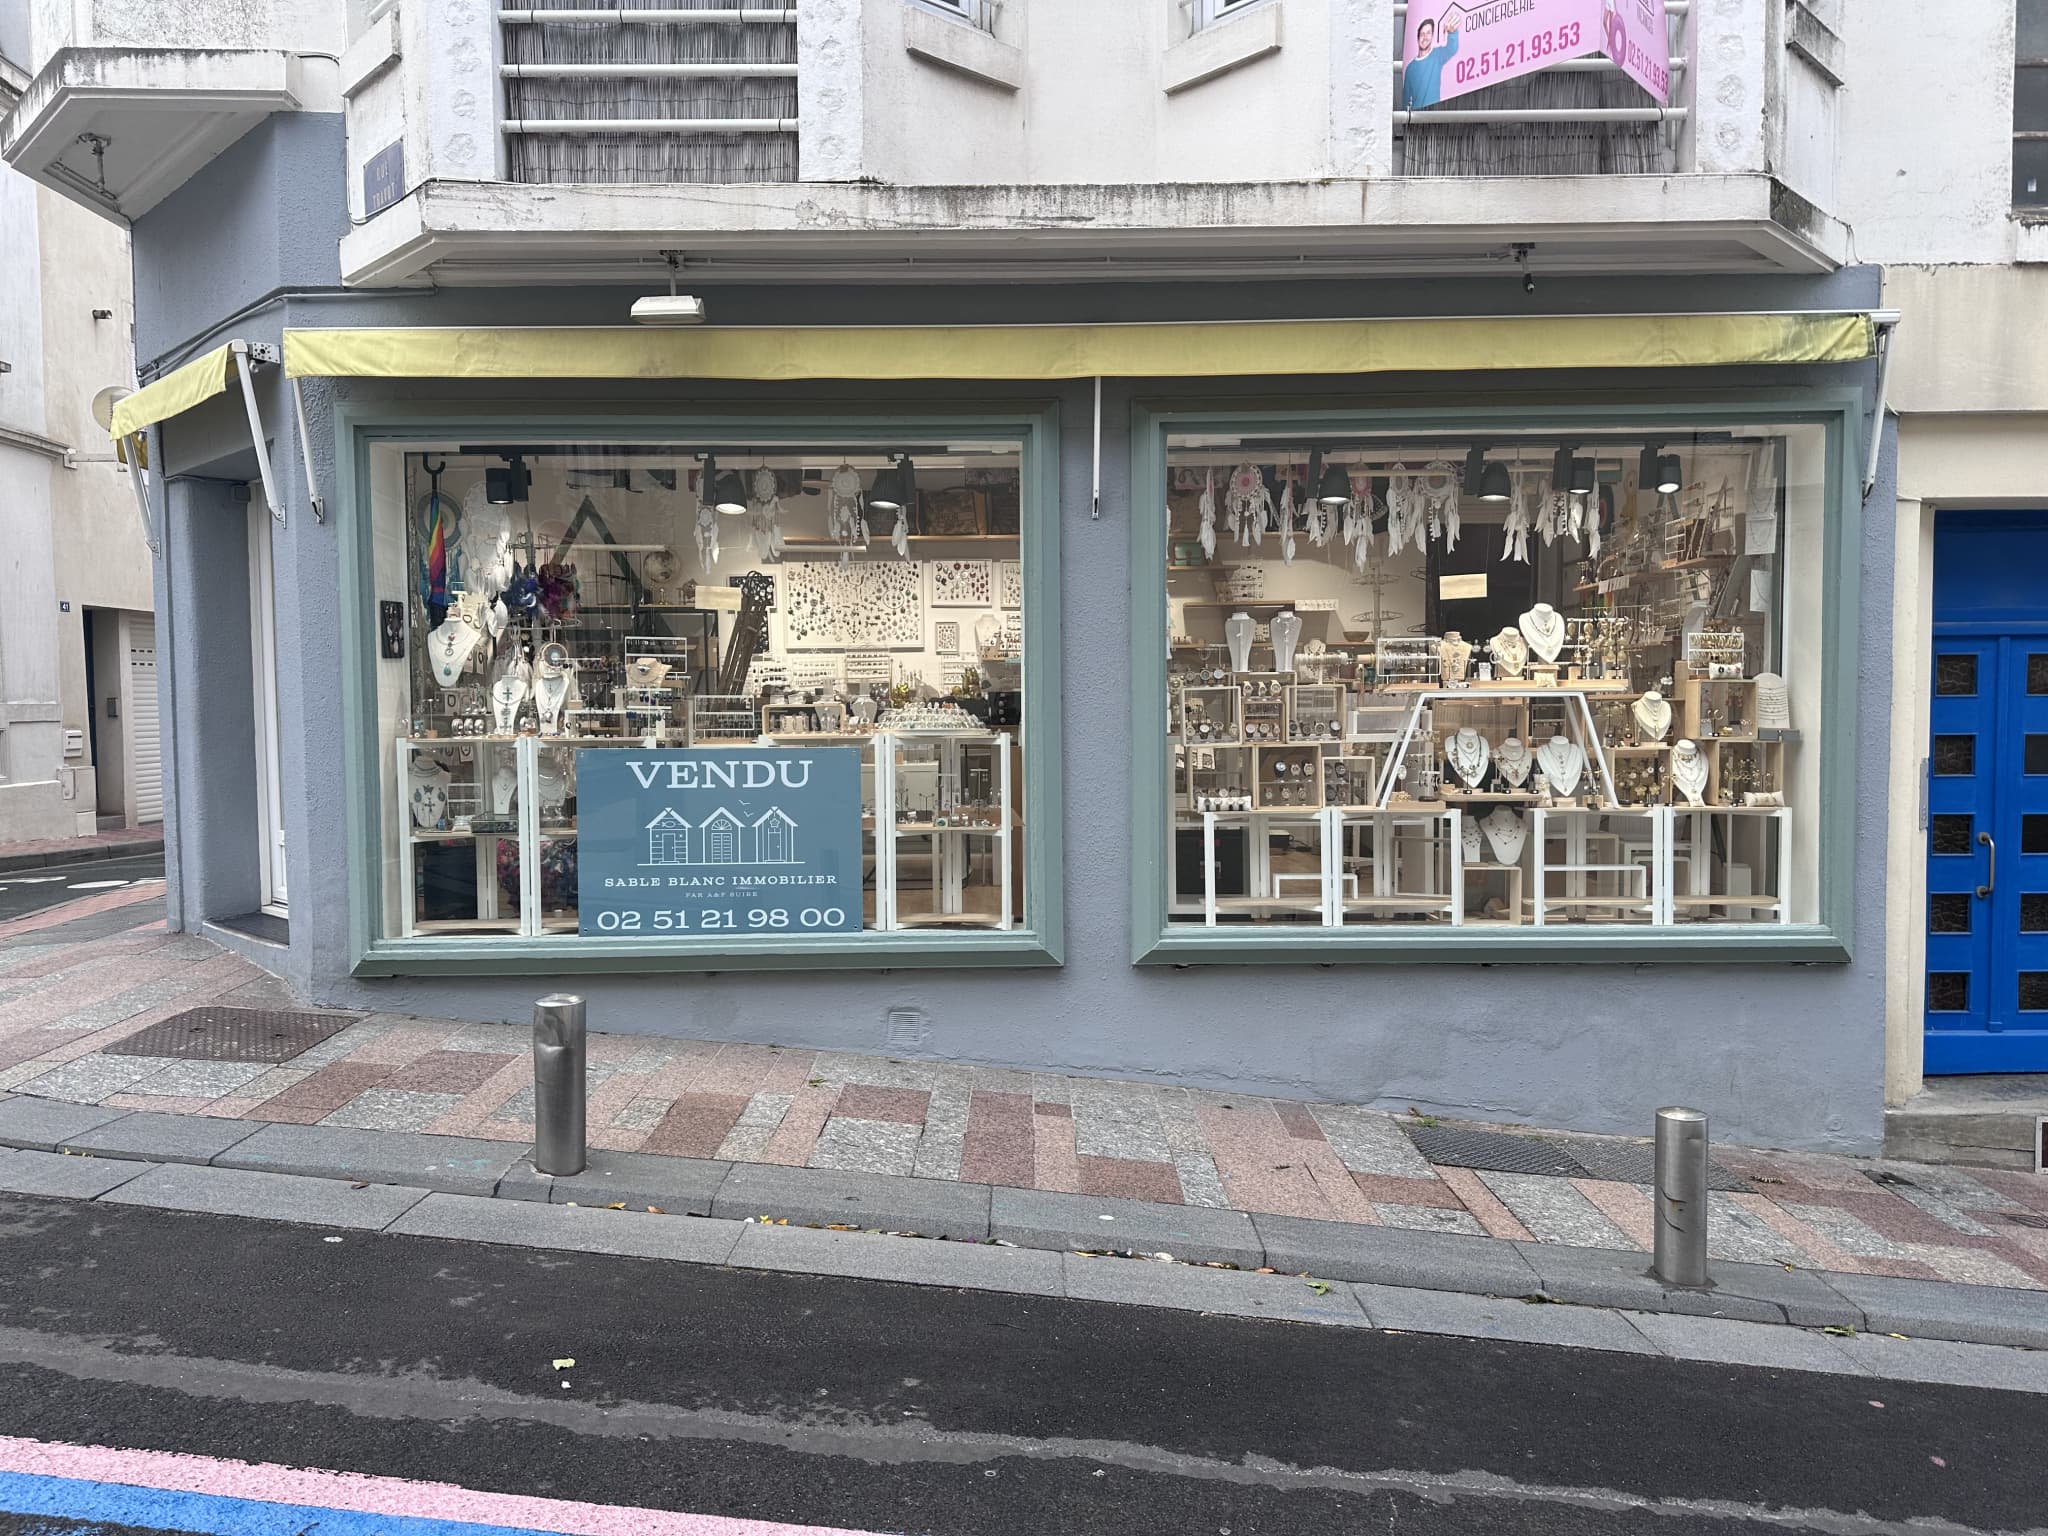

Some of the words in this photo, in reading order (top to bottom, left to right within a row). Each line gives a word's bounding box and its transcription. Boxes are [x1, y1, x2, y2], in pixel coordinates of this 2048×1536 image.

[1456, 21, 1581, 84] 02.51.21.93.53
[625, 760, 813, 789] VENDU
[604, 877, 661, 887] SABLE
[668, 876, 725, 886] BLANC
[732, 875, 838, 886] IMMOBILIER
[597, 910, 641, 930] 02
[653, 910, 689, 929] 51
[701, 909, 737, 928] 21
[748, 908, 789, 927] 98
[800, 907, 845, 927] 00
